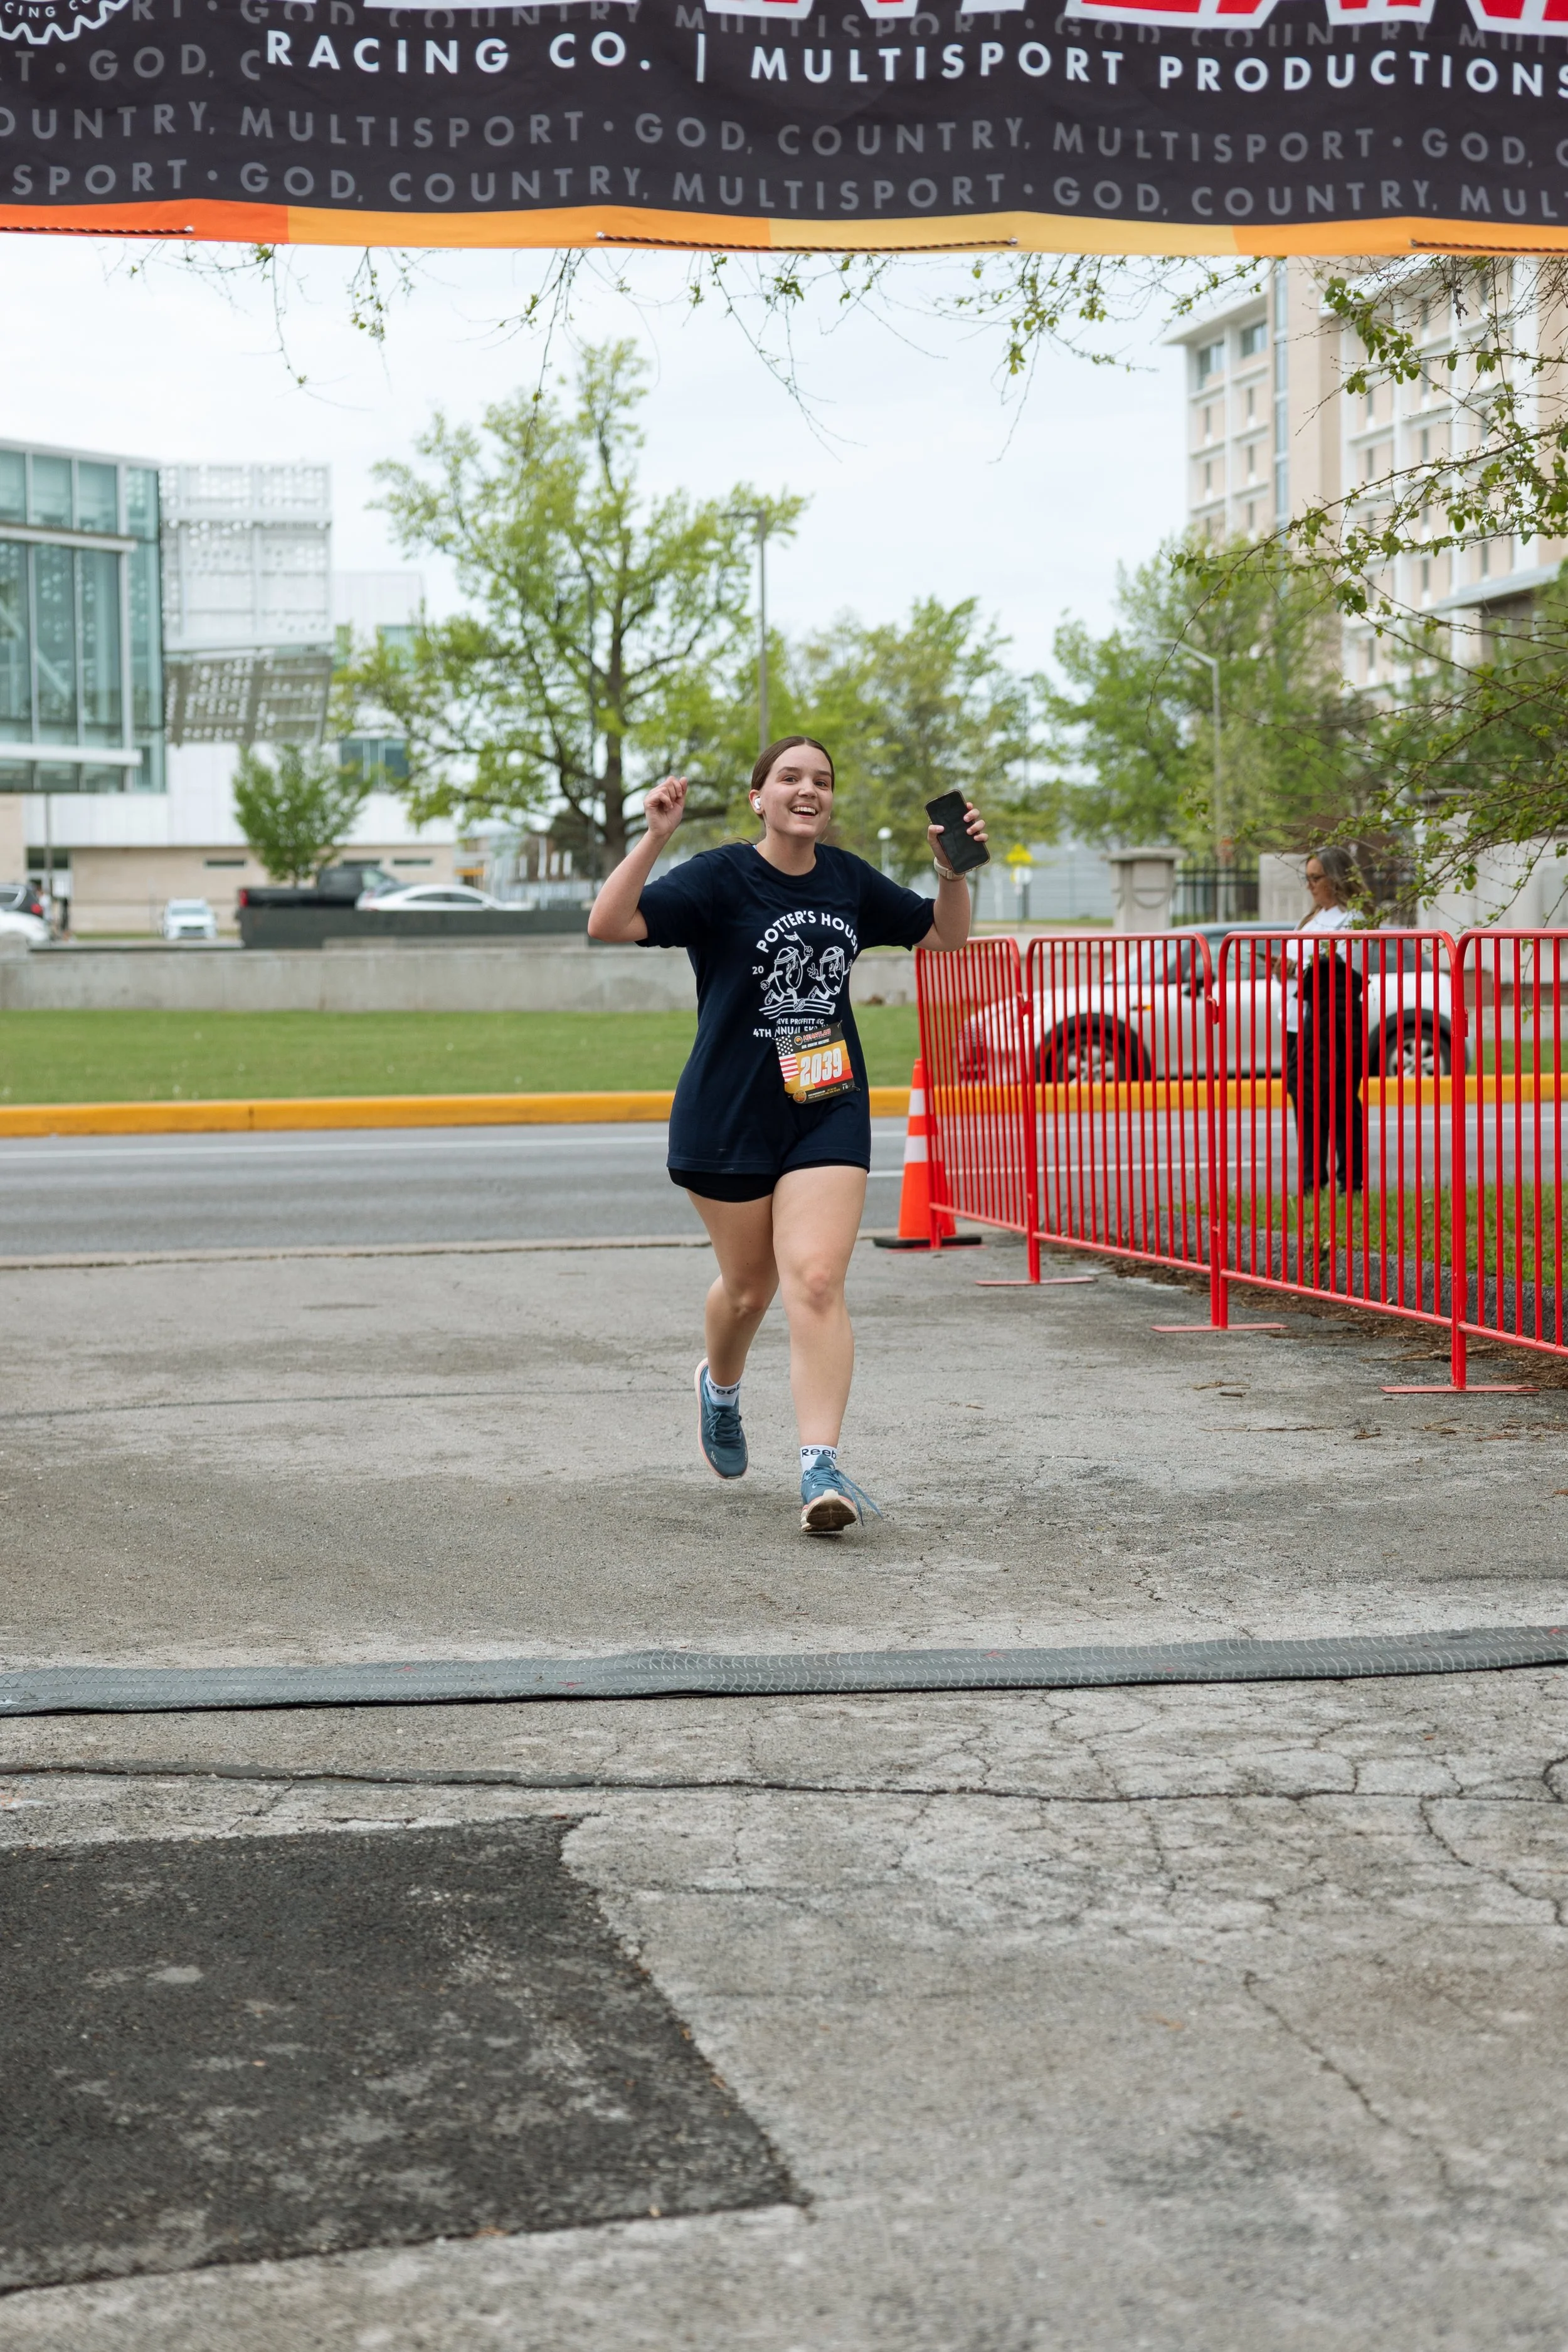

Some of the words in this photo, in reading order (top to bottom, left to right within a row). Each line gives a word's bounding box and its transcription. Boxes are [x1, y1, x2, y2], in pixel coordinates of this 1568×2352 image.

[89, 45, 215, 81] GOD,
[267, 29, 510, 75] RACING
[549, 31, 652, 71] CO.
[750, 41, 1124, 85] MULTISPORT
[240, 107, 583, 147] MULTISPORT
[635, 113, 752, 155] GOD,
[778, 118, 1030, 156] COUNTRY,
[1054, 122, 1373, 163] MULTISPORT
[1422, 129, 1532, 168] GOD,
[12, 159, 187, 195] SPORT
[240, 162, 363, 203] GOD,
[389, 166, 648, 203] COUNTRY,
[672, 172, 1005, 211] MULTISPORT
[1054, 177, 1168, 216] GOD,
[1192, 180, 1437, 217] COUNTRY,
[1461, 184, 1568, 218] MUL
[756, 911, 816, 953] POTTER'S
[752, 966, 764, 975] 20
[753, 1029, 772, 1037] 4TH
[800, 1047, 842, 1087] 2039
